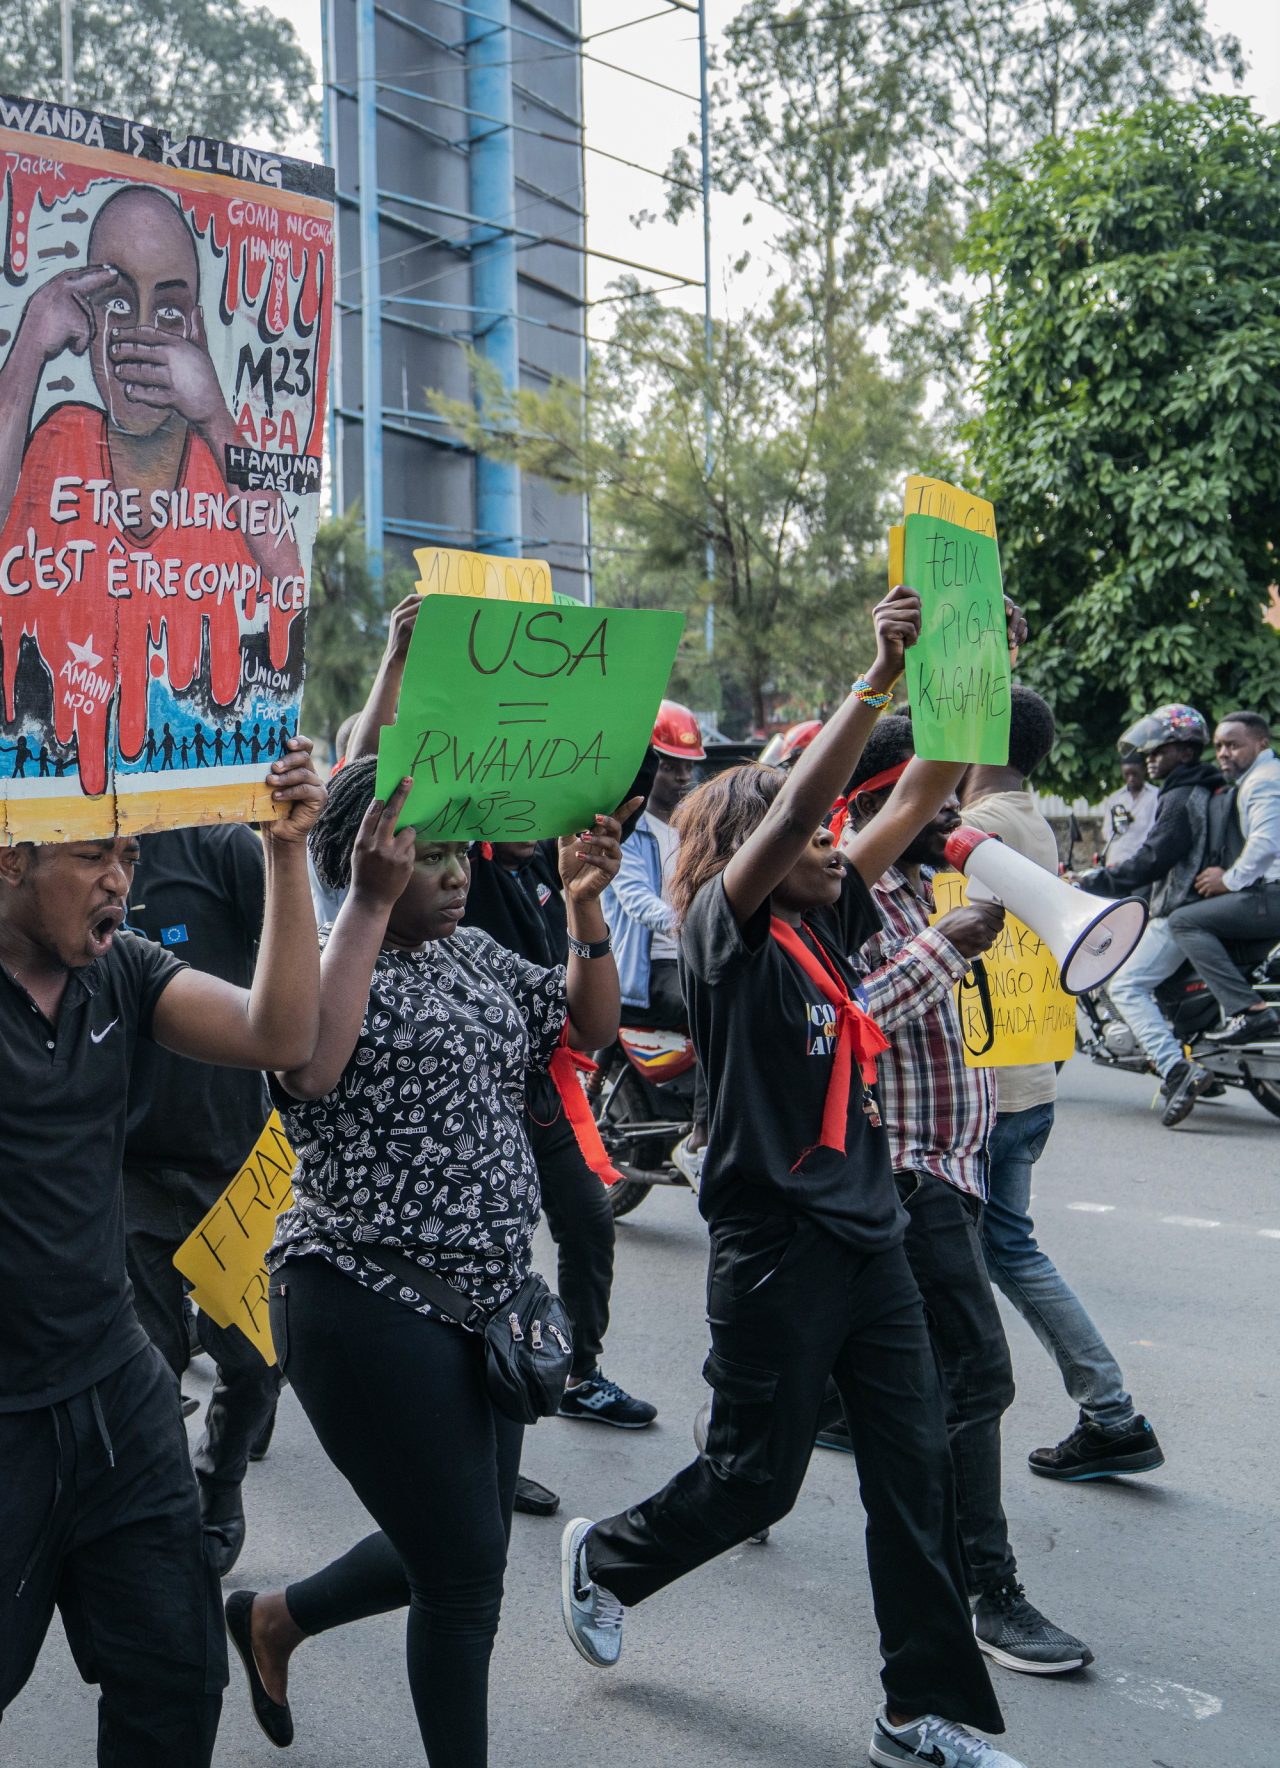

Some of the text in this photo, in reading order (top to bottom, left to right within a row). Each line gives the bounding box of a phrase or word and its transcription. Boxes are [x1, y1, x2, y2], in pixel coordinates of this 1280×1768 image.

[123, 122, 145, 158] IS
[162, 136, 282, 189] KILLING
[228, 200, 279, 236] GOMA
[234, 342, 312, 410] M23
[234, 402, 299, 455] APA
[230, 447, 319, 478] HAMUNA
[150, 487, 299, 548] SILENCIEUX
[0, 528, 96, 595] C'EST
[925, 532, 982, 590] FELIX
[468, 609, 609, 678] USA
[941, 600, 1003, 657] PIGA
[60, 660, 111, 704] AMANI
[919, 663, 1007, 720] KAGAME
[410, 730, 611, 784] RWANDA
